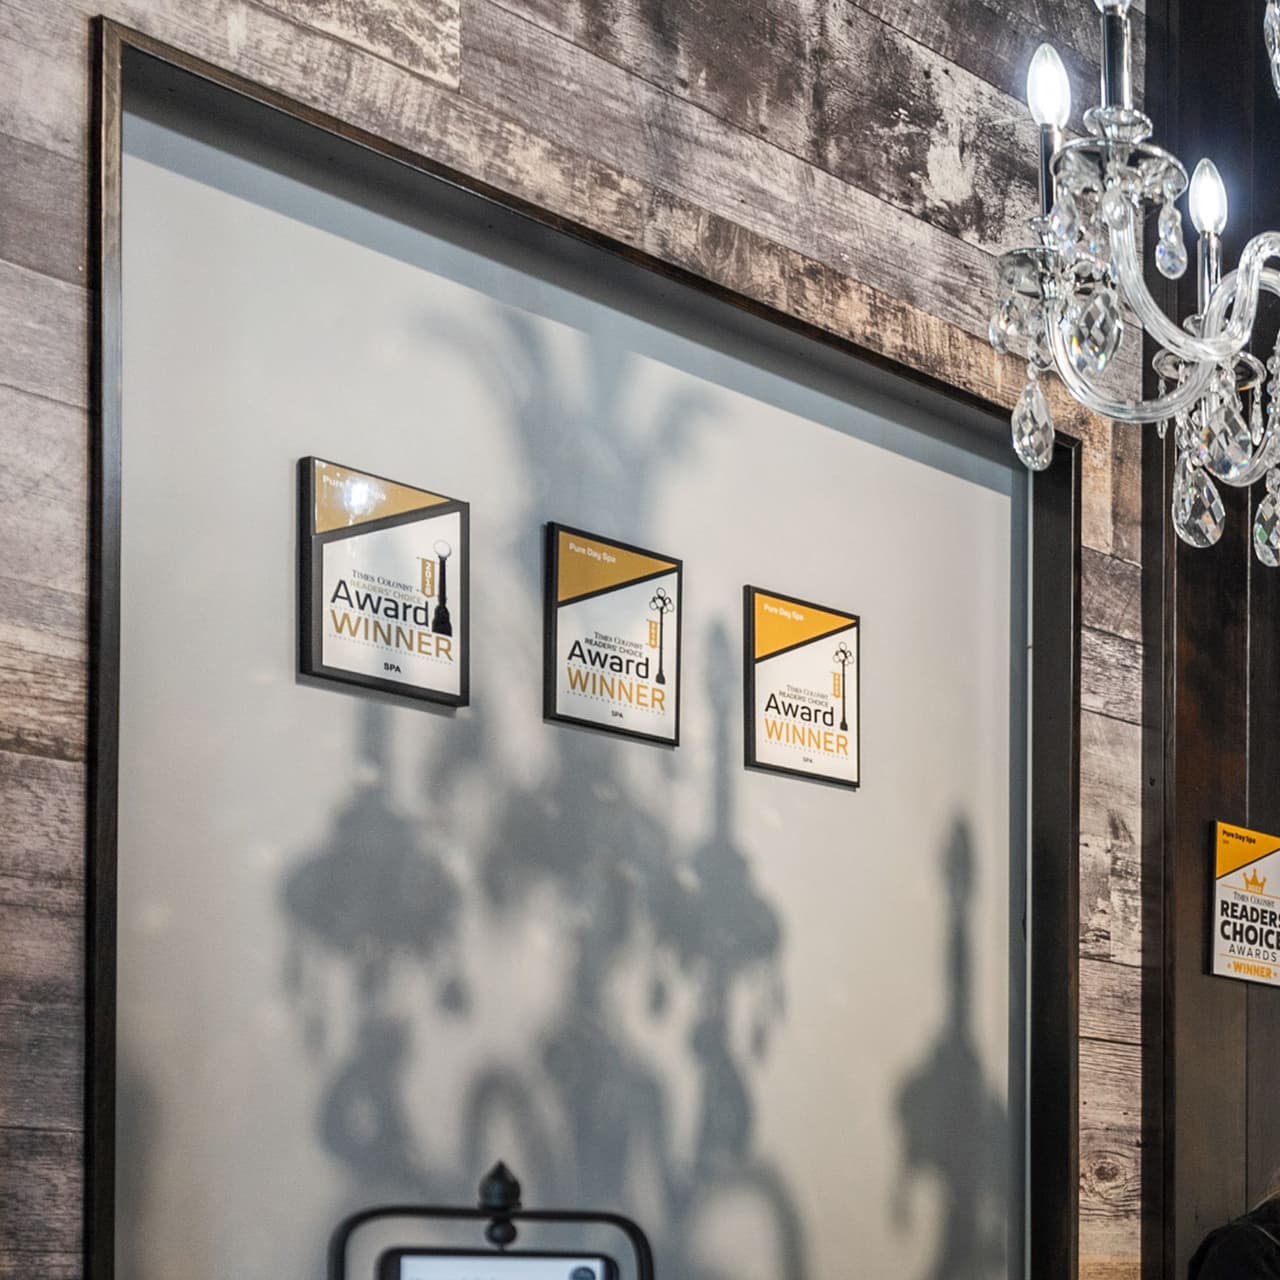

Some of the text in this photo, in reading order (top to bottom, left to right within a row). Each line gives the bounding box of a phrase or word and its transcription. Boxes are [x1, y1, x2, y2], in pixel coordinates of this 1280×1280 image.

[568, 543, 616, 563] Pure Day Spa
[352, 570, 414, 593] TIMES COLONIST
[330, 579, 429, 627] Award
[393, 591, 422, 604] CHOICE
[330, 609, 453, 662] WINNER
[568, 640, 649, 679] Award
[619, 647, 644, 658] CHOICE
[384, 662, 401, 673] SPA
[568, 667, 665, 711] WINNER
[611, 710, 623, 719] SPA
[765, 693, 834, 727] Award
[765, 717, 848, 756] WINNER
[1229, 944, 1277, 962] AWARDS
[1233, 961, 1272, 978] WINNER
